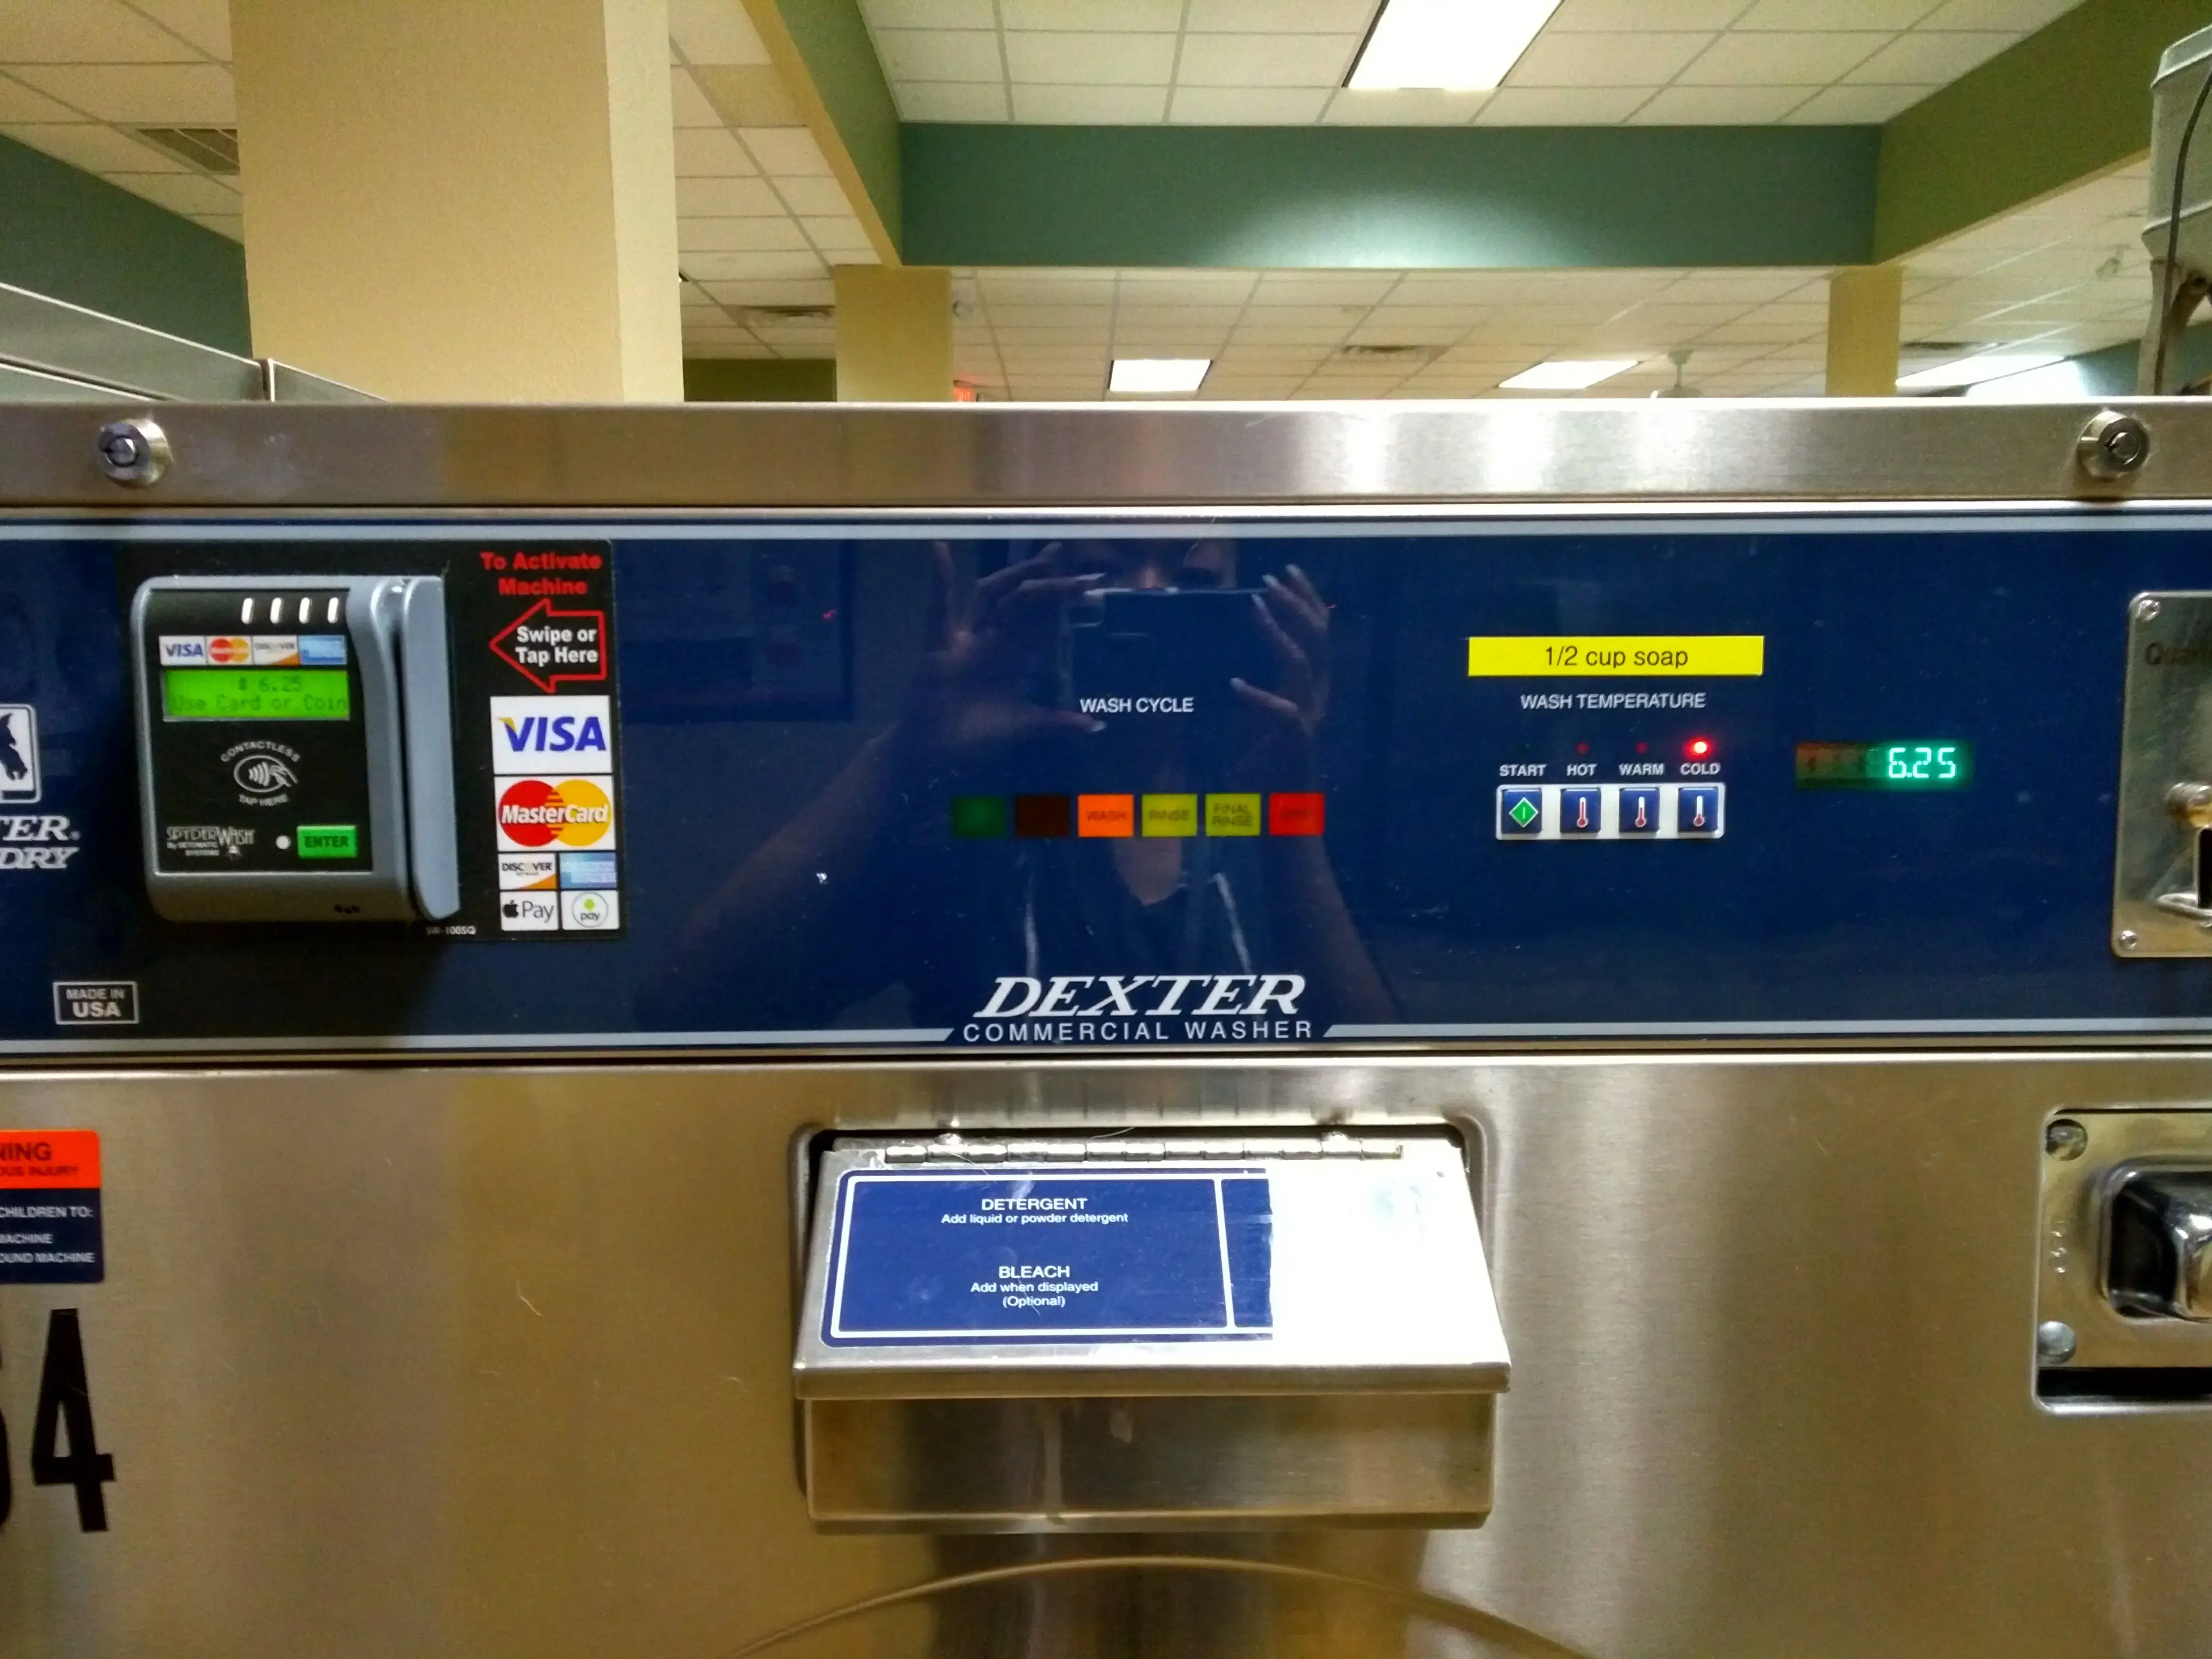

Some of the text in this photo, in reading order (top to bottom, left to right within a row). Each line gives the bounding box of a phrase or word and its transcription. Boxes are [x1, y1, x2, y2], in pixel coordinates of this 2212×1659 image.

[480, 551, 602, 569] To Activate
[498, 577, 588, 595] Machine
[516, 625, 597, 646] Swipe or
[164, 643, 204, 658] VISA
[515, 646, 599, 667] Tap Here
[1545, 646, 1688, 669] 1/2 cup soap
[258, 676, 302, 692] 6.25
[215, 694, 261, 710] Card
[270, 698, 292, 710] or
[303, 694, 346, 710] Coin
[1080, 698, 1195, 714] WASH CYCLE
[1520, 692, 1707, 710] WASH TEMPERATURE
[498, 716, 607, 752] VISA
[220, 741, 301, 763] CONTACTLESS
[1499, 764, 1546, 777] START
[1566, 763, 1598, 776] HOT
[1619, 763, 1665, 776] WARM
[1679, 761, 1721, 775] COLD
[1888, 747, 1957, 779] 6.25
[501, 803, 609, 825] MasterCard
[1086, 810, 1127, 822] WASH
[1148, 810, 1190, 821] RINSE
[1214, 803, 1250, 815] FINAL
[1212, 815, 1253, 827] RINSE
[304, 835, 349, 849] ENTER
[522, 900, 554, 923] Pay
[581, 912, 600, 921] pay
[66, 988, 125, 1000] MADE IN
[973, 974, 1306, 1018] DEXTER
[72, 1001, 121, 1018] USA
[963, 1020, 1312, 1043] COMMERCIAL WASHER
[69, 1206, 94, 1218] TO:
[982, 1198, 1088, 1211] DETERGENT
[941, 1214, 967, 1224] Add
[970, 1214, 1003, 1225] liquid
[1021, 1214, 1066, 1225] powder
[1070, 1213, 1129, 1225] detergent
[35, 1252, 96, 1263] MACHINE
[999, 1266, 1070, 1278] BLEACH
[970, 1281, 1099, 1293] Add when displayed
[1002, 1296, 1066, 1309] (Optional)
[0, 1308, 116, 1533] 4
